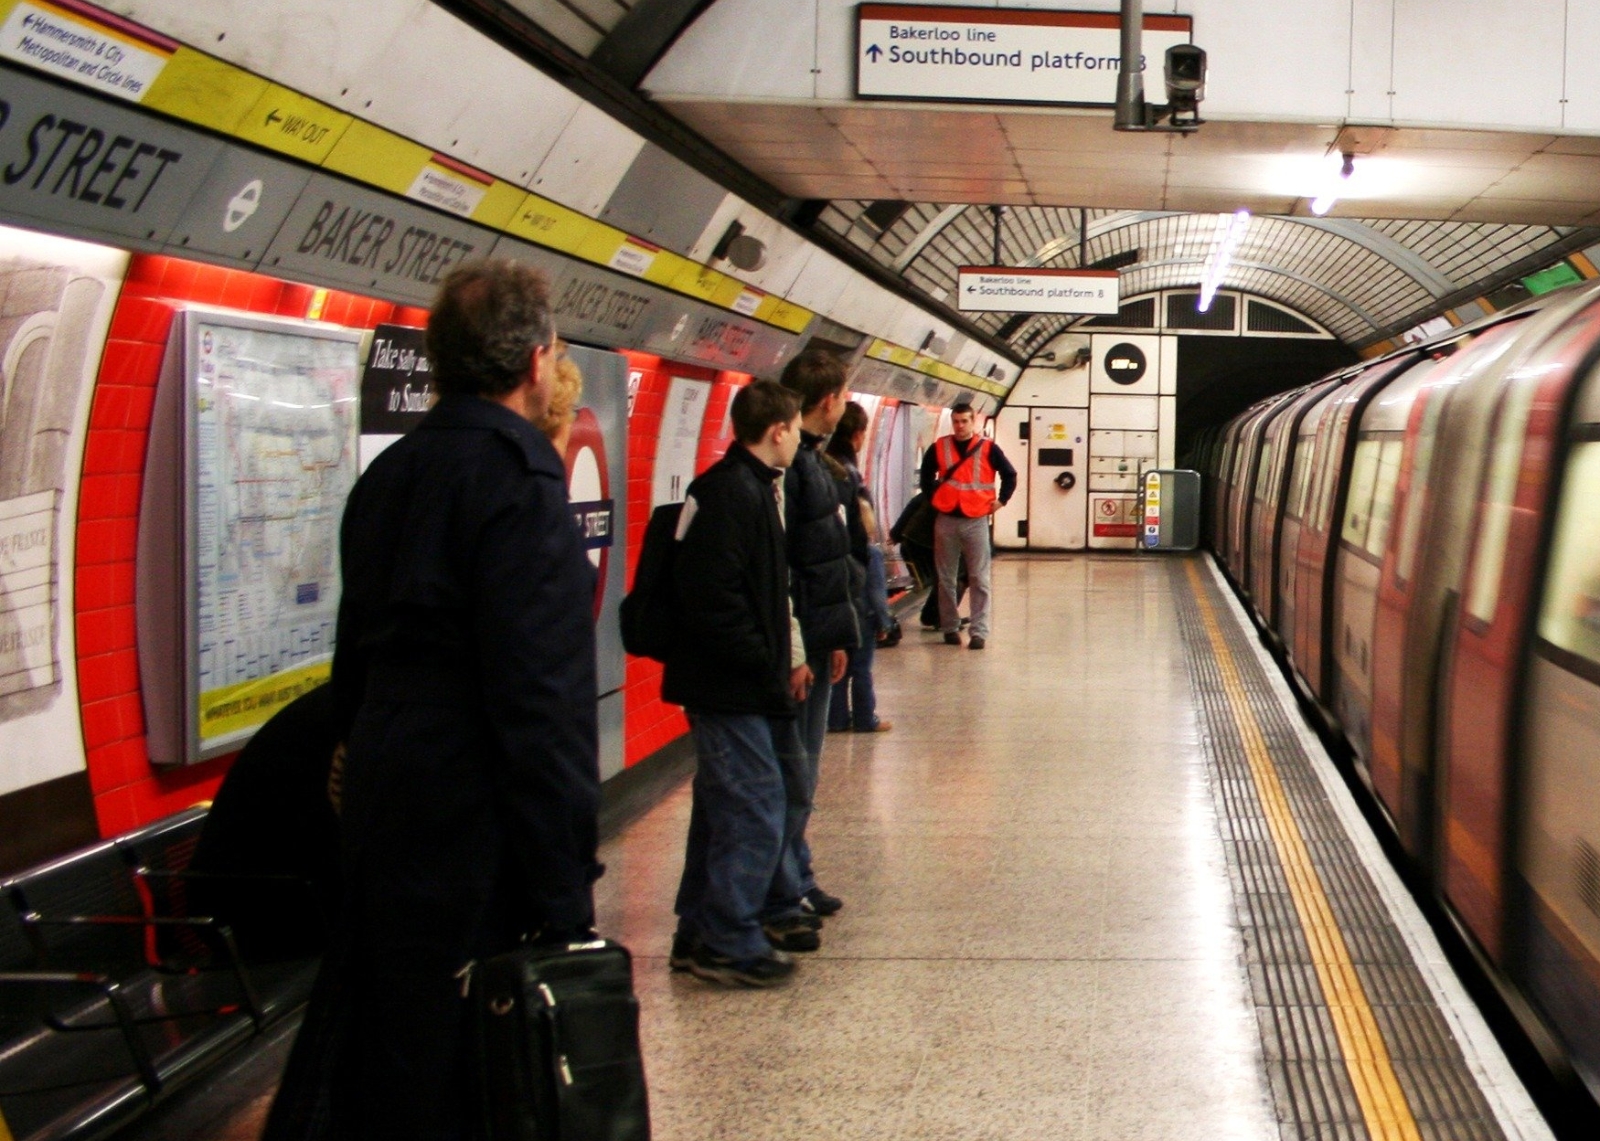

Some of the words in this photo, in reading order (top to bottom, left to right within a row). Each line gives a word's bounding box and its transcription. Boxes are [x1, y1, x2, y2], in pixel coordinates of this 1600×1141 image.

[31, 16, 98, 52] Hammersmith
[96, 42, 107, 56] &
[105, 46, 126, 66] City
[890, 26, 961, 42] Bakerloo
[967, 28, 996, 42] line
[17, 36, 80, 70] Metropolitan
[78, 60, 99, 76] and
[97, 66, 123, 86] Circle
[121, 75, 143, 93] lines
[889, 46, 1022, 68] Southbound
[1031, 50, 1121, 72] platform
[281, 115, 310, 136] WAY
[302, 123, 331, 145] OUT
[4, 113, 183, 213] STREET
[297, 200, 395, 269] BAKER
[384, 226, 475, 284] STREET
[979, 276, 1014, 285] Bakerloo
[1016, 277, 1032, 285] line
[979, 286, 1044, 297] Southbound
[1047, 288, 1095, 299] platform
[1097, 289, 1104, 298] 8
[372, 339, 399, 370] Take
[388, 387, 401, 412] to
